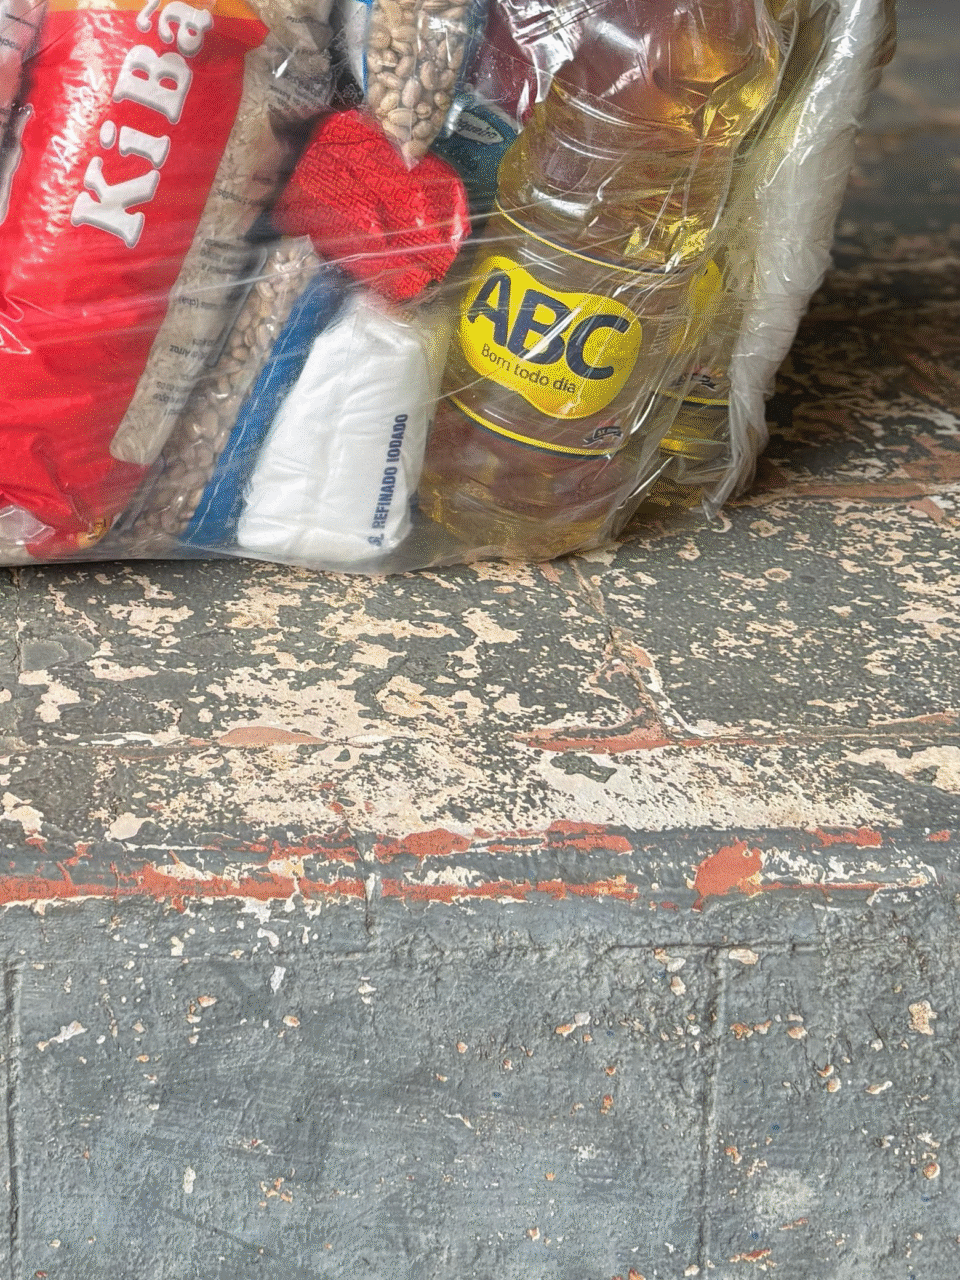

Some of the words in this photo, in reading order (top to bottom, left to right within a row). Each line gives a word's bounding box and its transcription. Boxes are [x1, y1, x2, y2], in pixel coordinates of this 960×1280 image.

[51, 66, 105, 173] Arroz
[467, 273, 631, 382] ABC
[481, 343, 511, 371] Bom
[513, 364, 549, 386] todo
[553, 376, 576, 393] dia
[372, 467, 398, 530] REFINADO
[387, 414, 408, 461] IODADO
